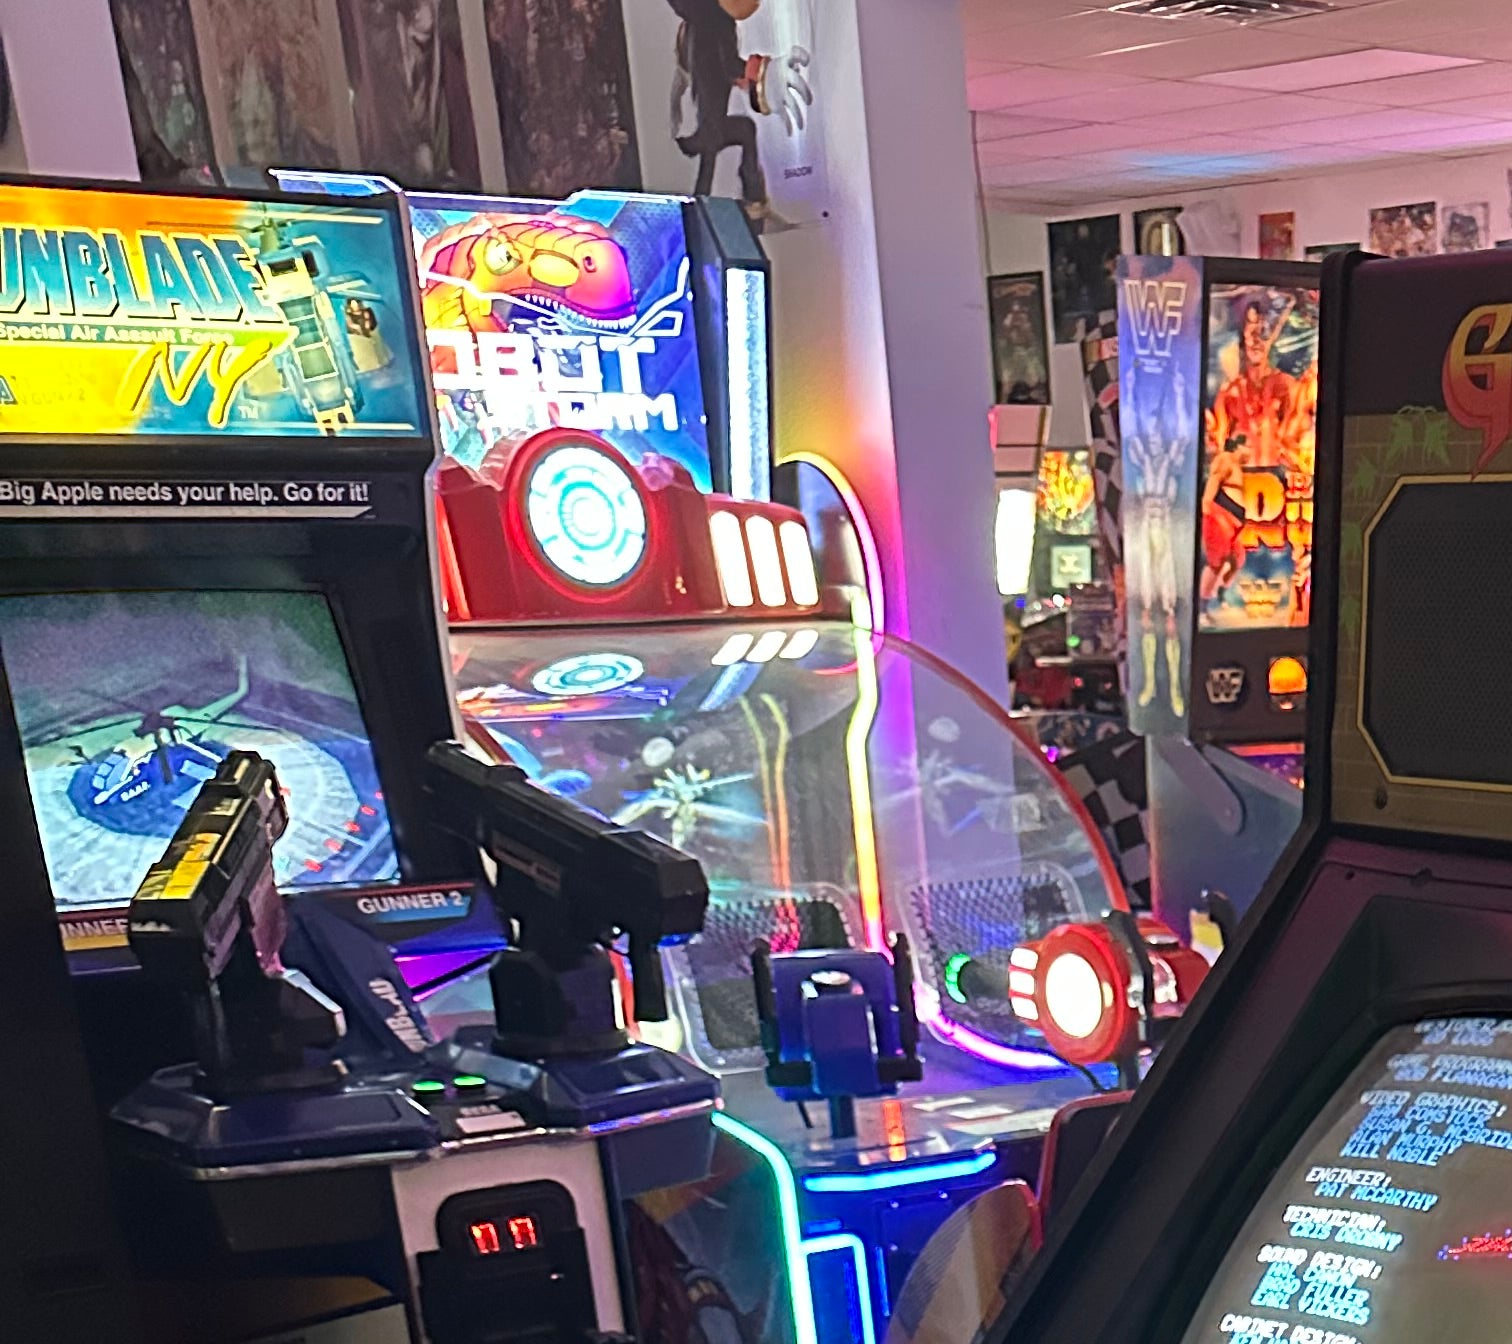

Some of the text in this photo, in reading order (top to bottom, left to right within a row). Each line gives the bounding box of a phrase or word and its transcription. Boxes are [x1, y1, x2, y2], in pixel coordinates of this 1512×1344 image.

[71, 325, 99, 341] Air
[0, 481, 369, 505] Big Apple needs your help. Go for it!
[357, 890, 465, 915] GUNNER 2
[1386, 1145, 1445, 1167] NOBLE
[1305, 1166, 1392, 1189] ENGINEER:
[1314, 1181, 1439, 1212] PAT MCCARTHY
